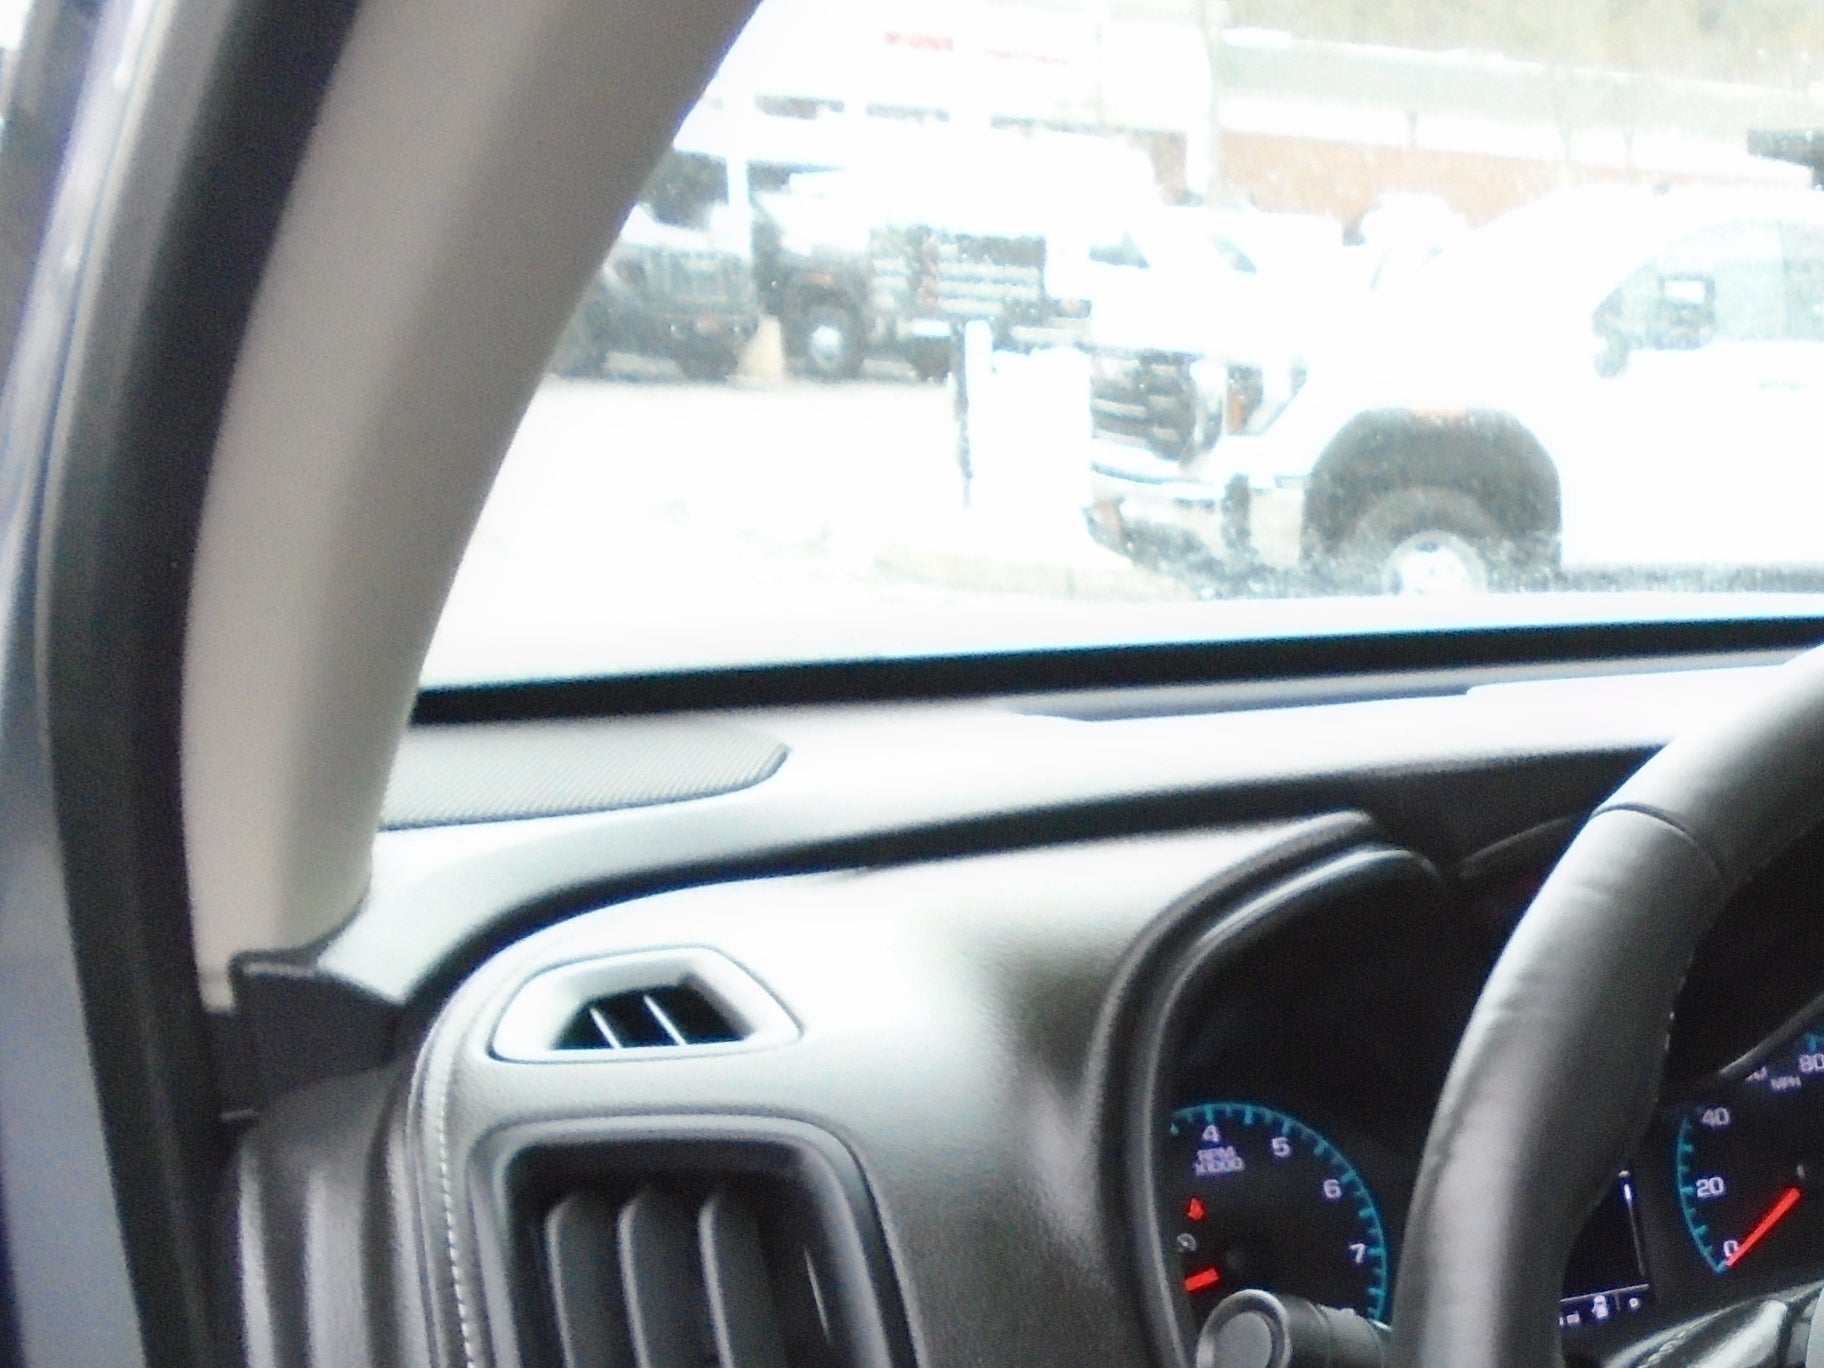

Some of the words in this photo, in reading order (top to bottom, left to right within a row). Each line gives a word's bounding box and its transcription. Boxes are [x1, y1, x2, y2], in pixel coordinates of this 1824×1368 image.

[1701, 1107, 1730, 1126] 40
[1202, 1125, 1220, 1142] 4
[1272, 1137, 1291, 1158] 5
[1323, 1179, 1342, 1199] 6
[1696, 1176, 1724, 1198] 20
[1350, 1243, 1366, 1264] 7
